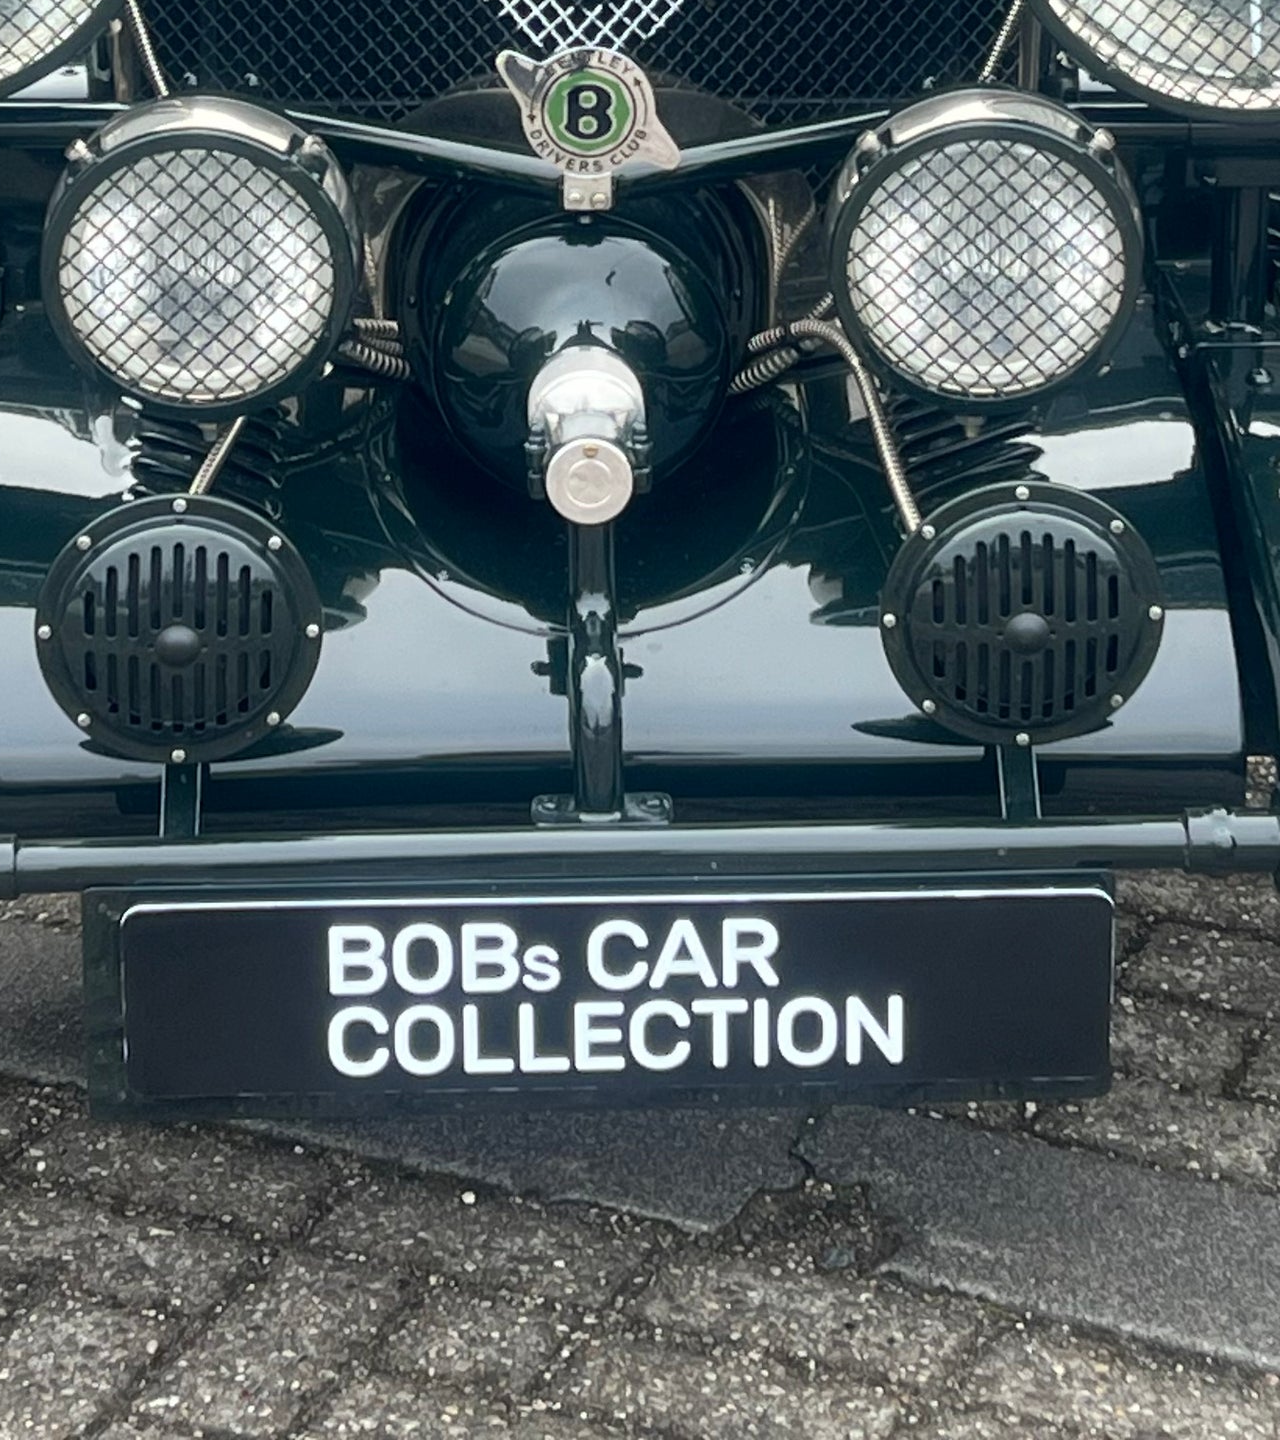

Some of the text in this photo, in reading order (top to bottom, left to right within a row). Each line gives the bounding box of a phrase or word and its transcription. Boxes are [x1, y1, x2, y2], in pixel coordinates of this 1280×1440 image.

[544, 49, 634, 77] BENTLEY
[562, 82, 616, 142] B
[530, 128, 647, 172] DRIVERS CLUB
[327, 917, 780, 995] BOBs CAR
[327, 994, 904, 1077] COLLECTION
